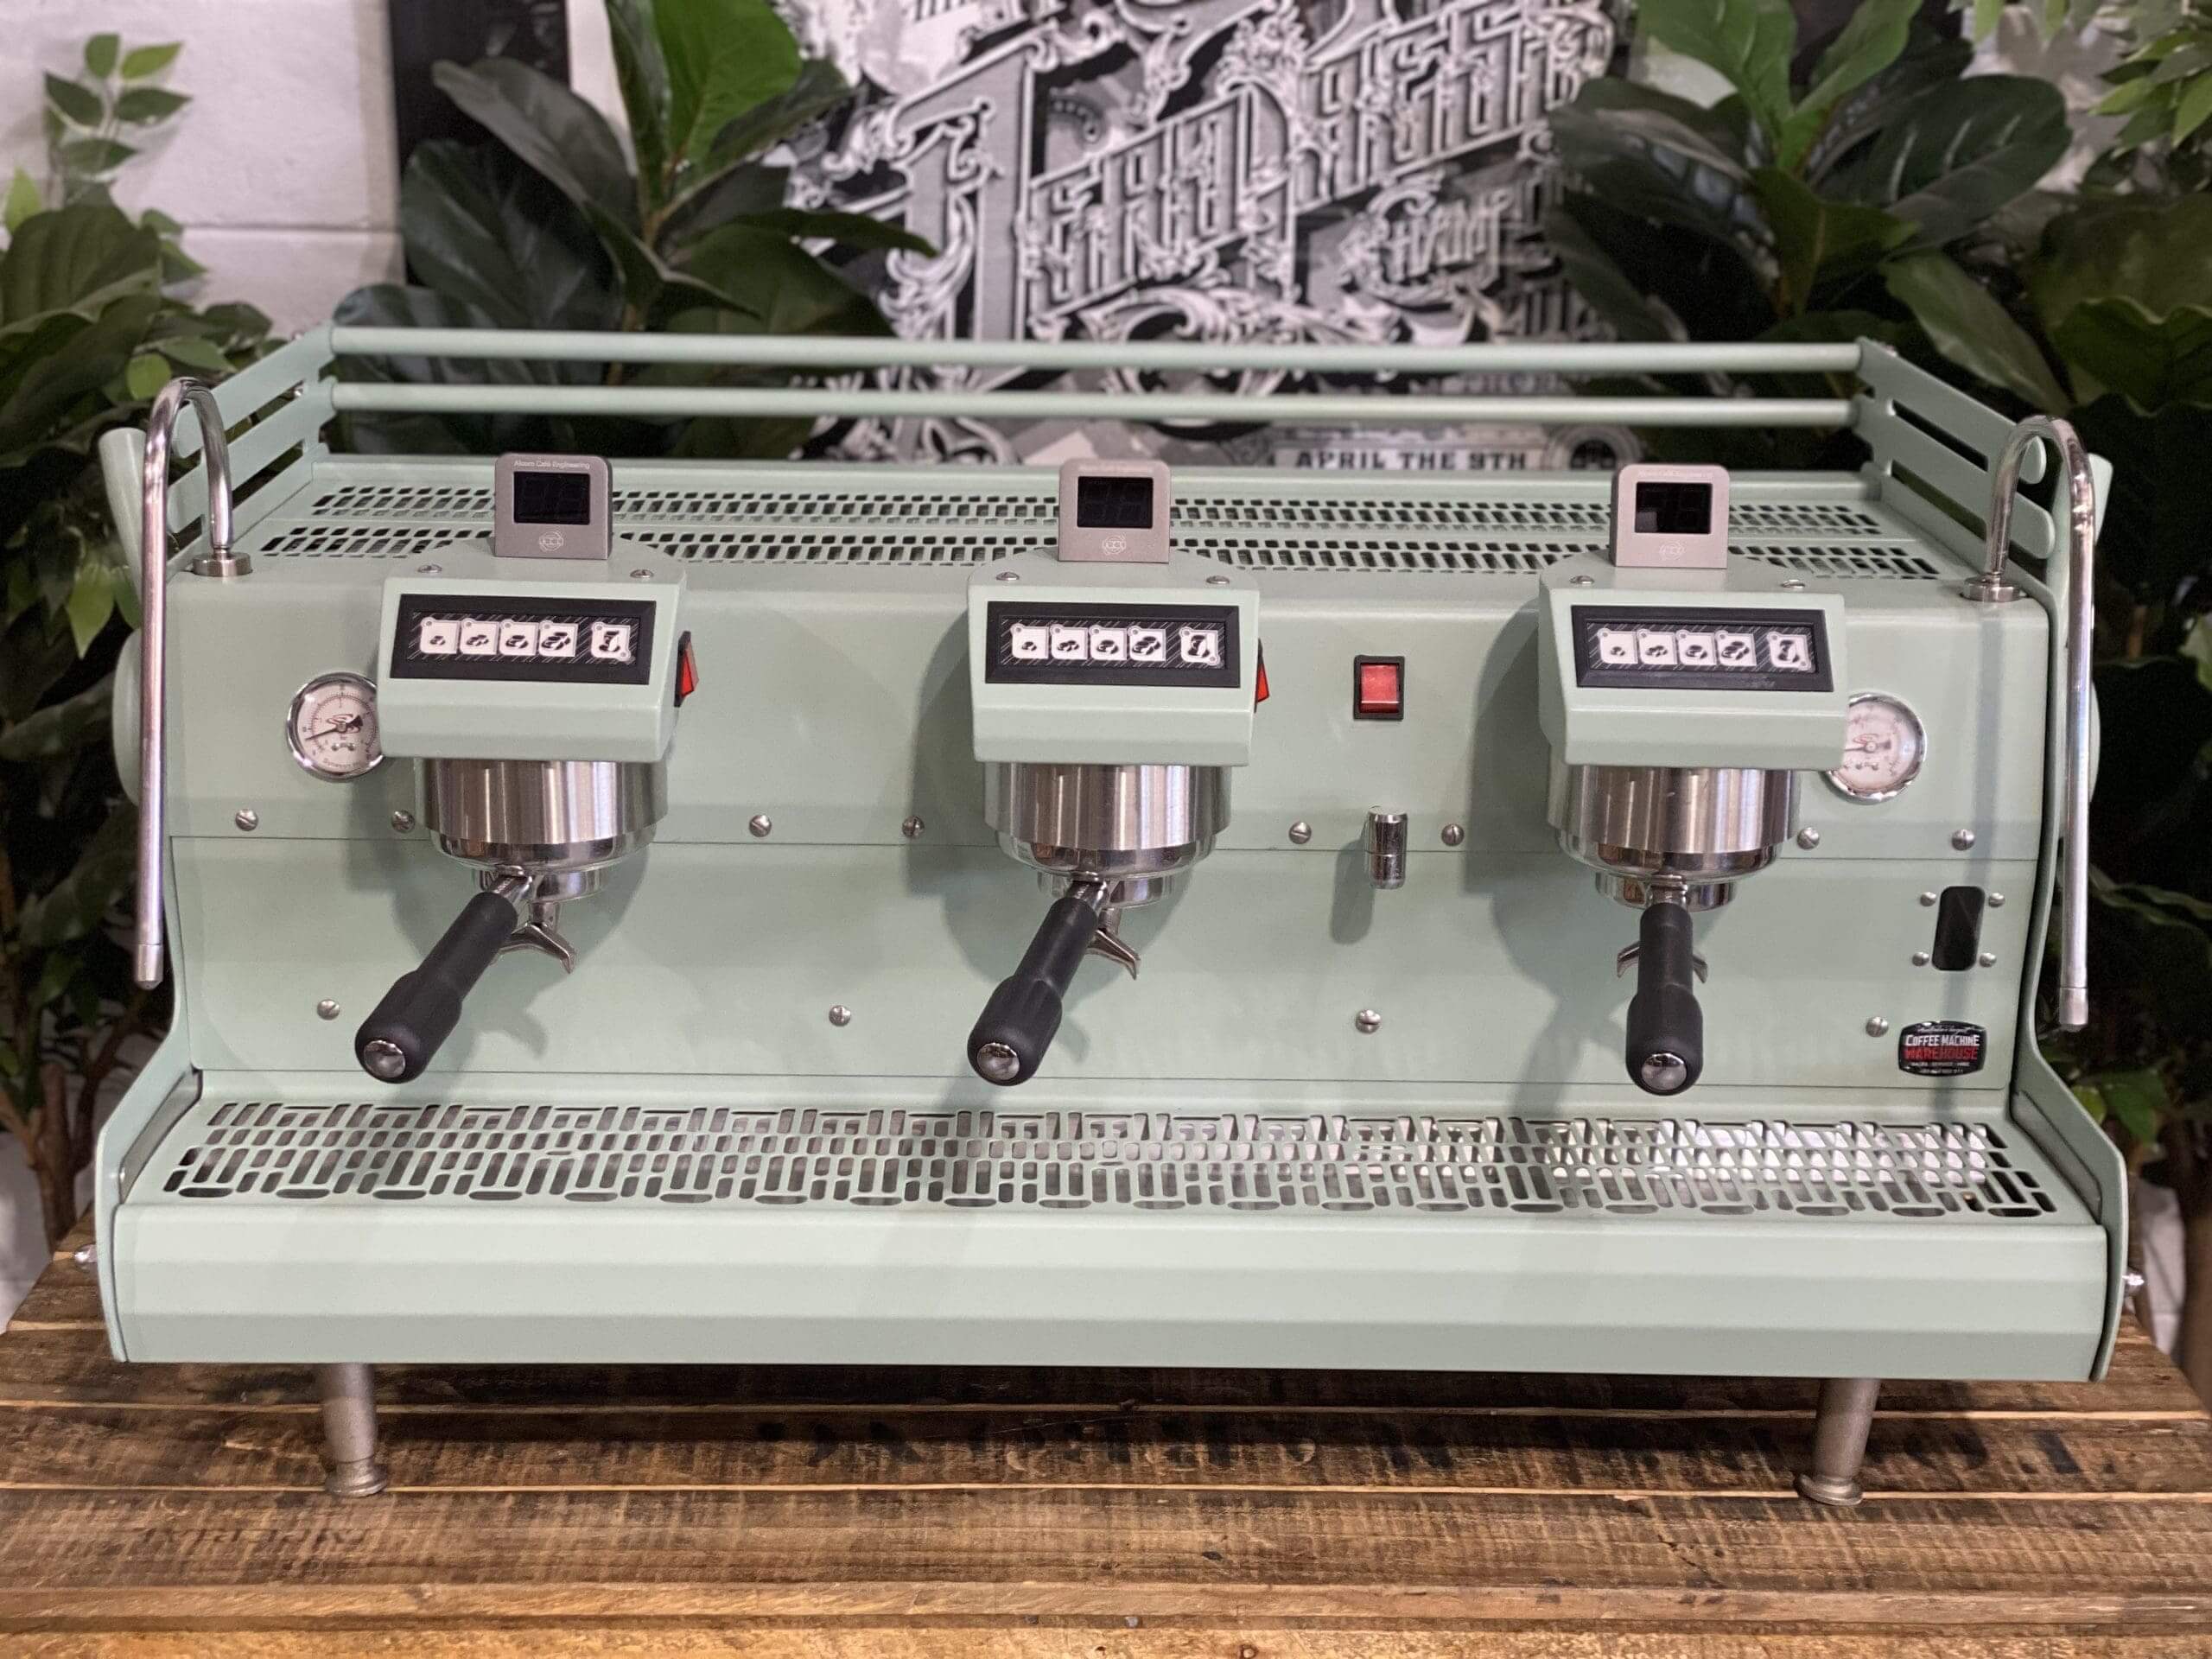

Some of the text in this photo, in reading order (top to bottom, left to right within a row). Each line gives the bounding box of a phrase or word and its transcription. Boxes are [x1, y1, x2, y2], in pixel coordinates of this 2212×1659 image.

[1295, 451, 1527, 471] APRIL THE 9TH
[1905, 1034, 1980, 1047] COFFEE MACHINE
[1906, 1046, 1978, 1060] WAREHOUSE
